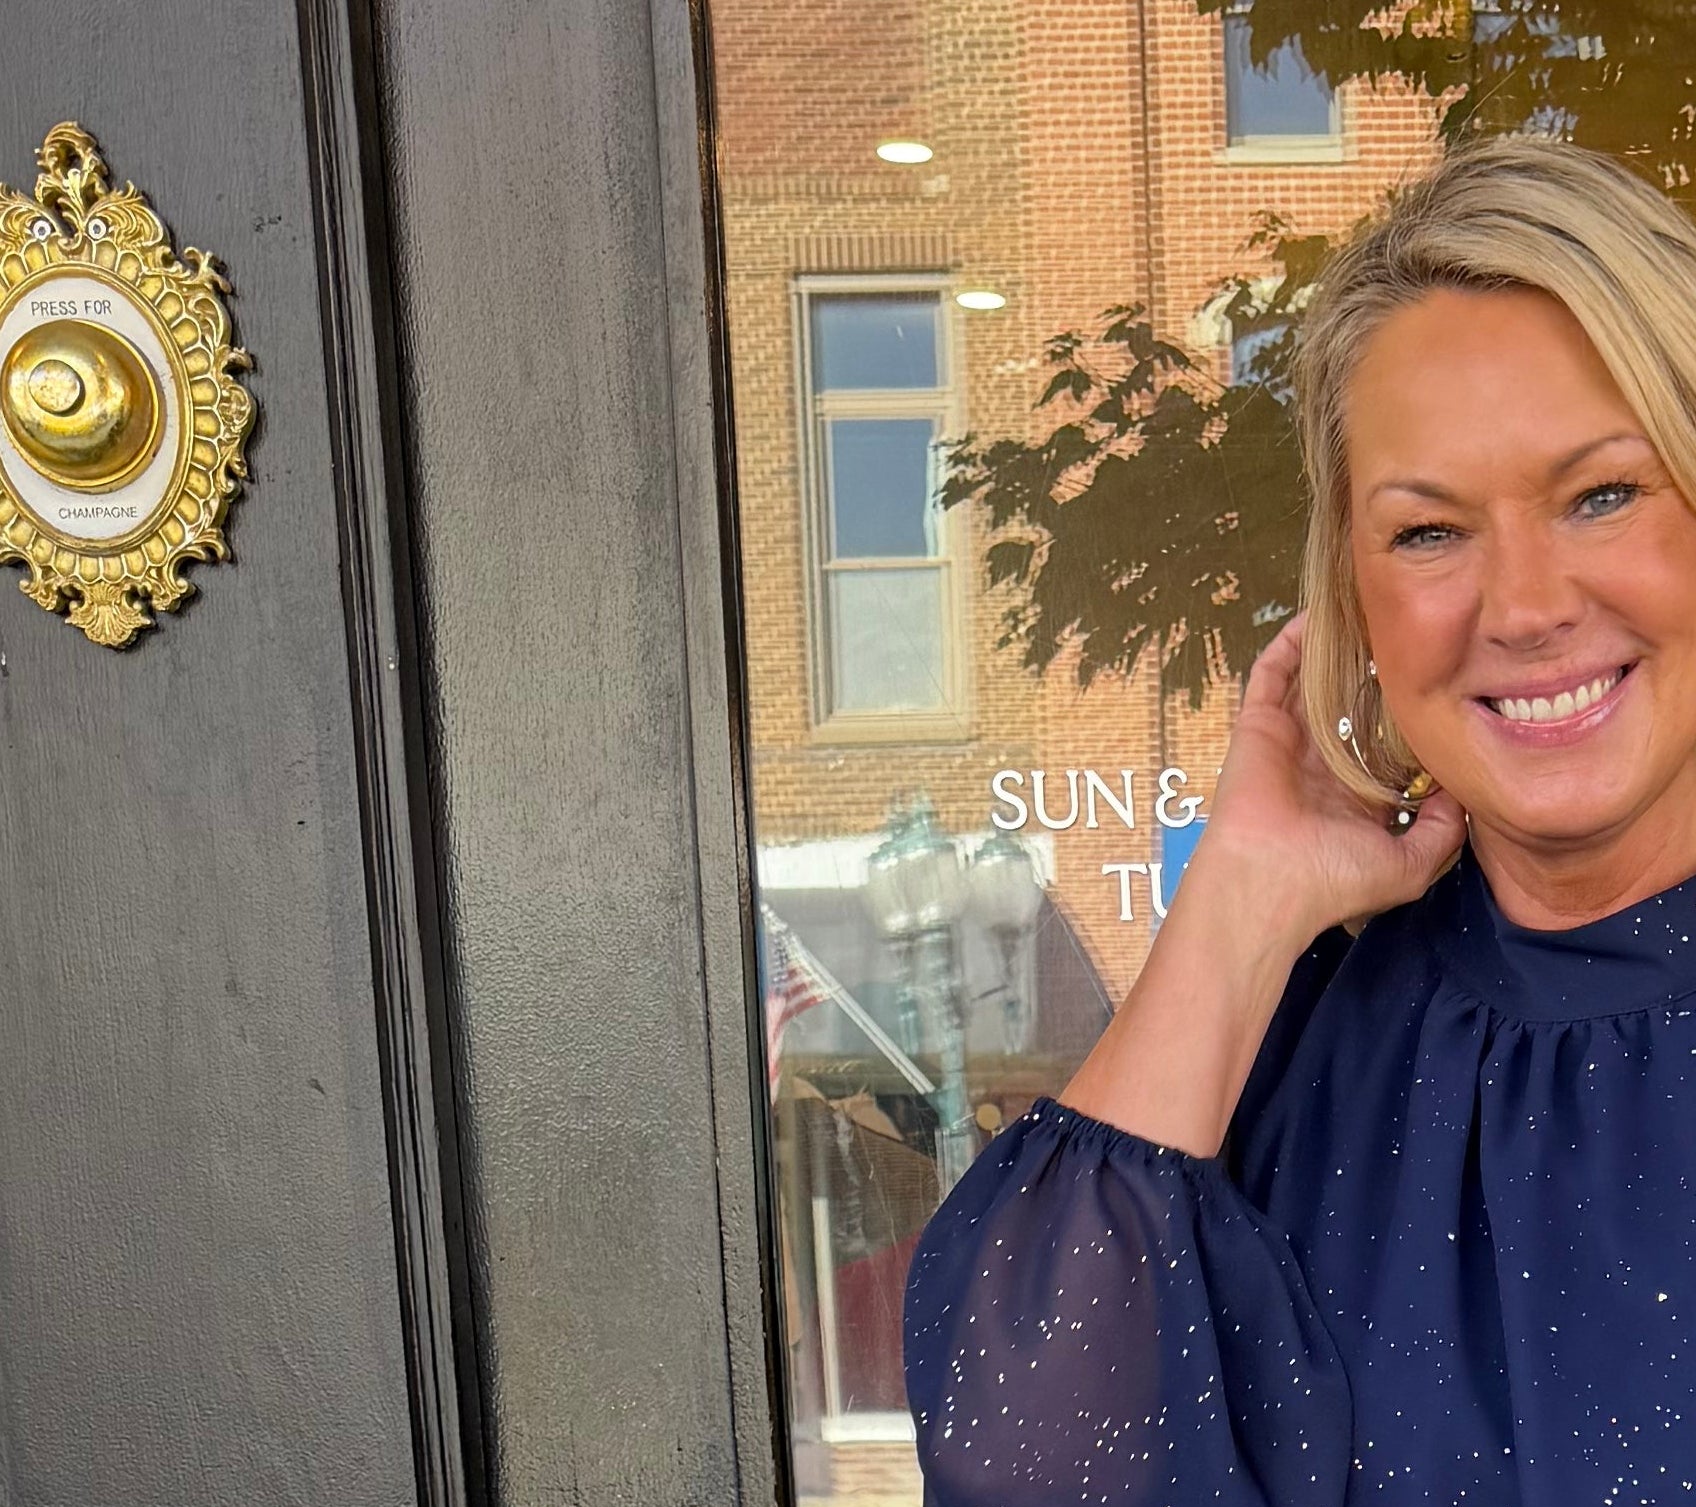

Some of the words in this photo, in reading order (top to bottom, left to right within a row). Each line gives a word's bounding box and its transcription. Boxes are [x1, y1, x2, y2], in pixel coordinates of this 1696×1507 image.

[31, 301, 78, 316] PRESS
[84, 300, 112, 315] FOR
[58, 506, 138, 519] CHAMPAGNE
[991, 769, 1136, 830] SUN
[1155, 767, 1205, 828] &
